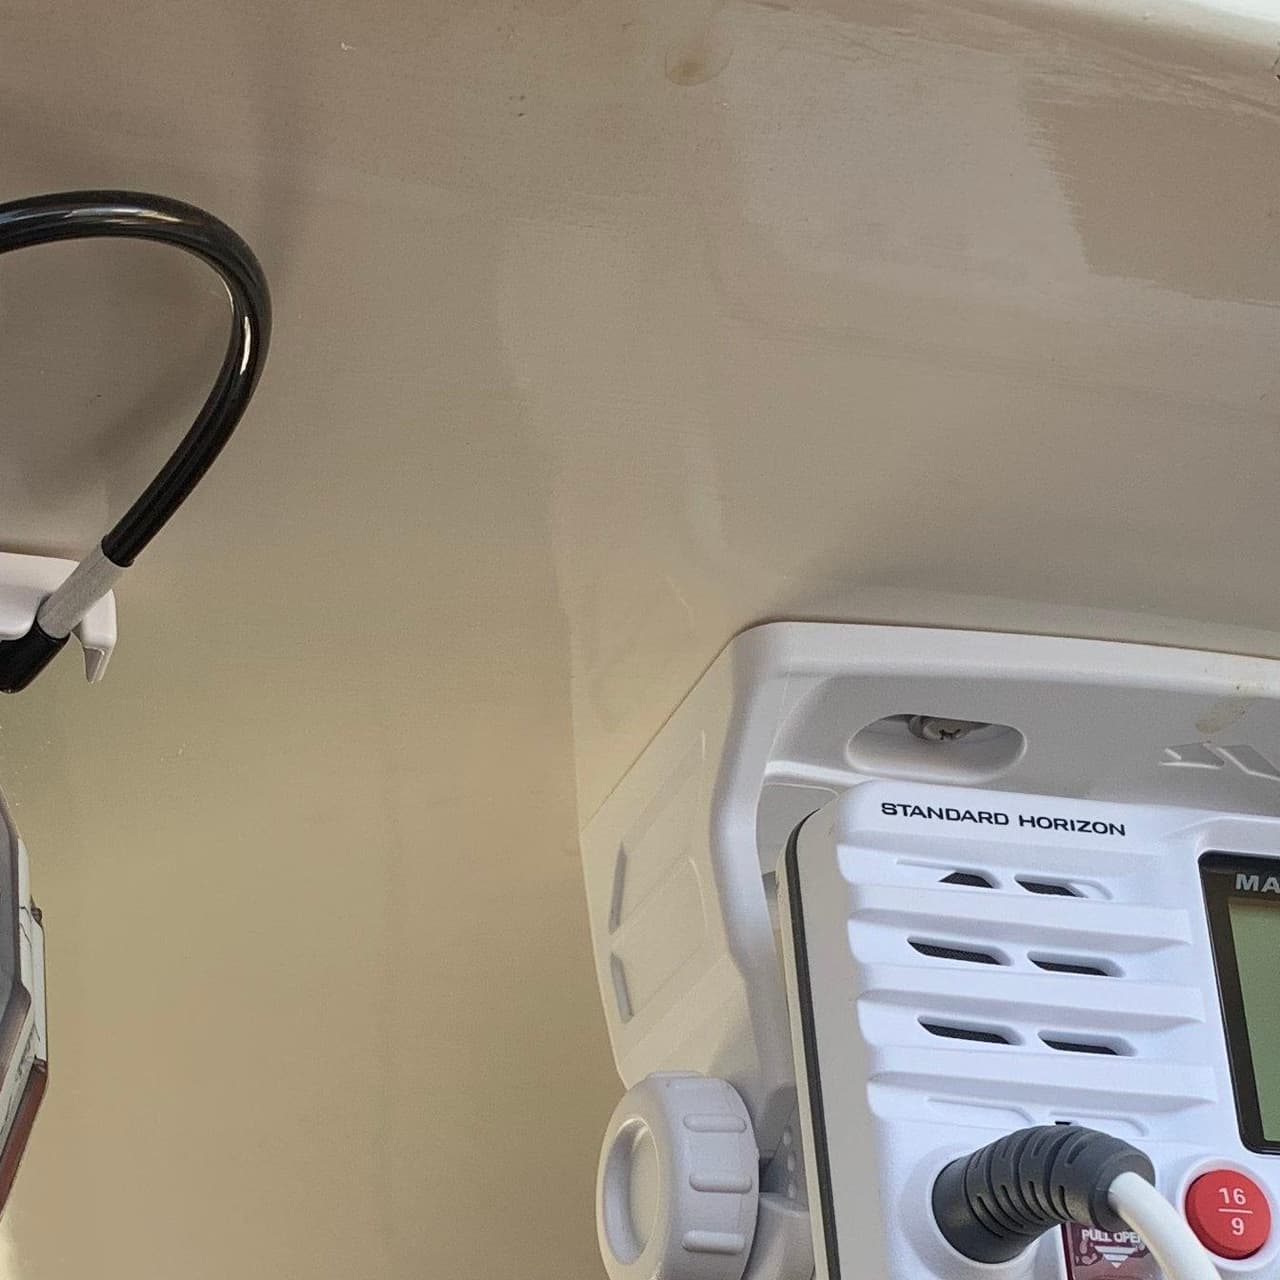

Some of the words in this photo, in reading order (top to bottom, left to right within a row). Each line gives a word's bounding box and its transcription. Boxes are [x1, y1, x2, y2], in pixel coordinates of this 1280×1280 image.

[880, 801, 1009, 827] STANDARD
[1018, 813, 1126, 837] HORIZON
[1218, 1186, 1247, 1205] 16
[1081, 1228, 1112, 1244] PULL
[1114, 1229, 1143, 1245] OPE
[1230, 1217, 1245, 1237] 9
